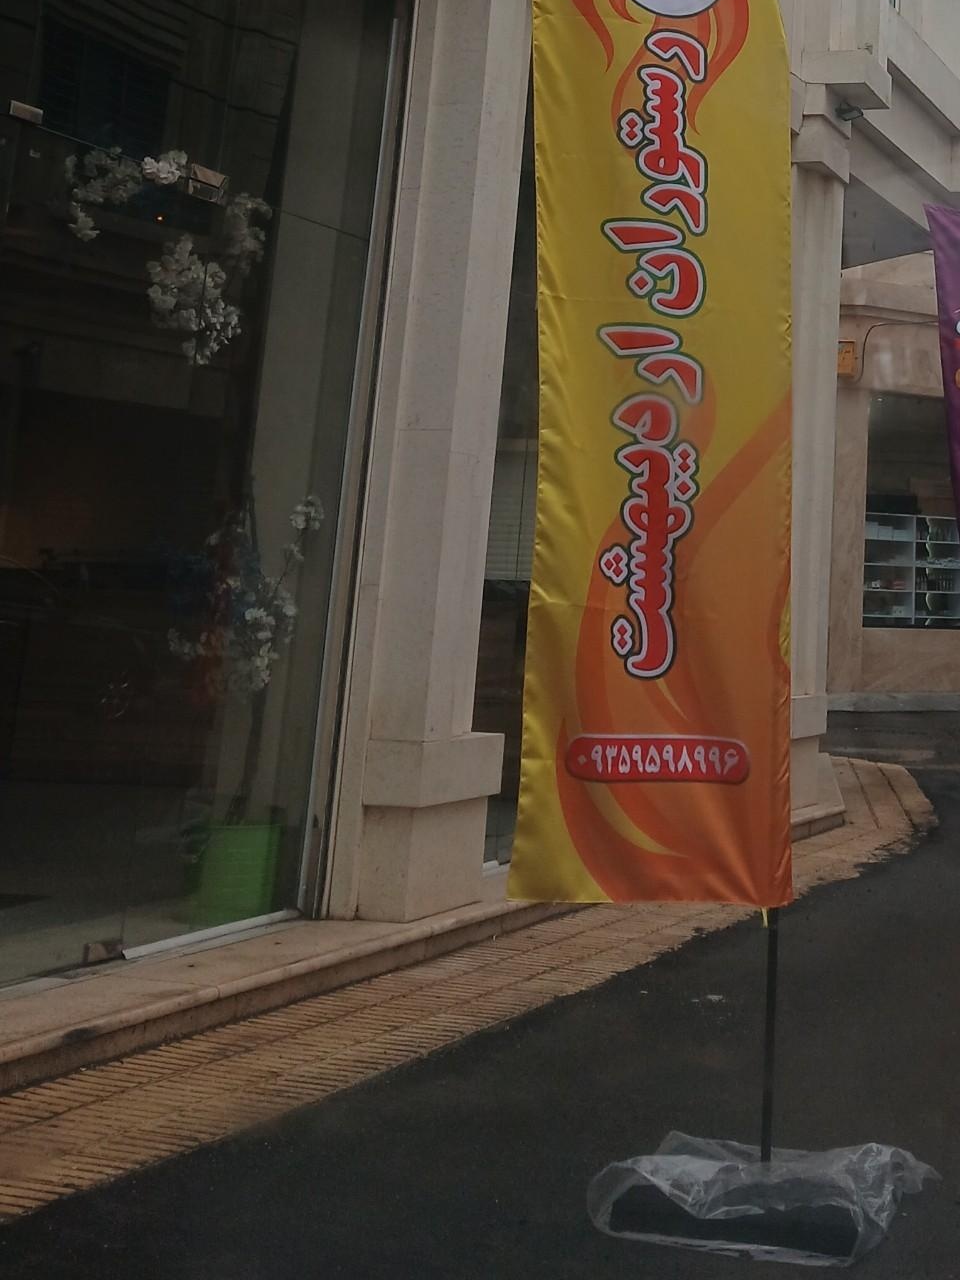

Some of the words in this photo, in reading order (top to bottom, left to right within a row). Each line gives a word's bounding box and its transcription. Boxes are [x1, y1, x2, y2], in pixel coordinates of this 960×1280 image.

[602, 29, 708, 317] رستوران
[598, 323, 703, 678] اردیبهشت
[577, 744, 740, 775] ۰۹۳۵۹۵۹۸۹۹۶
